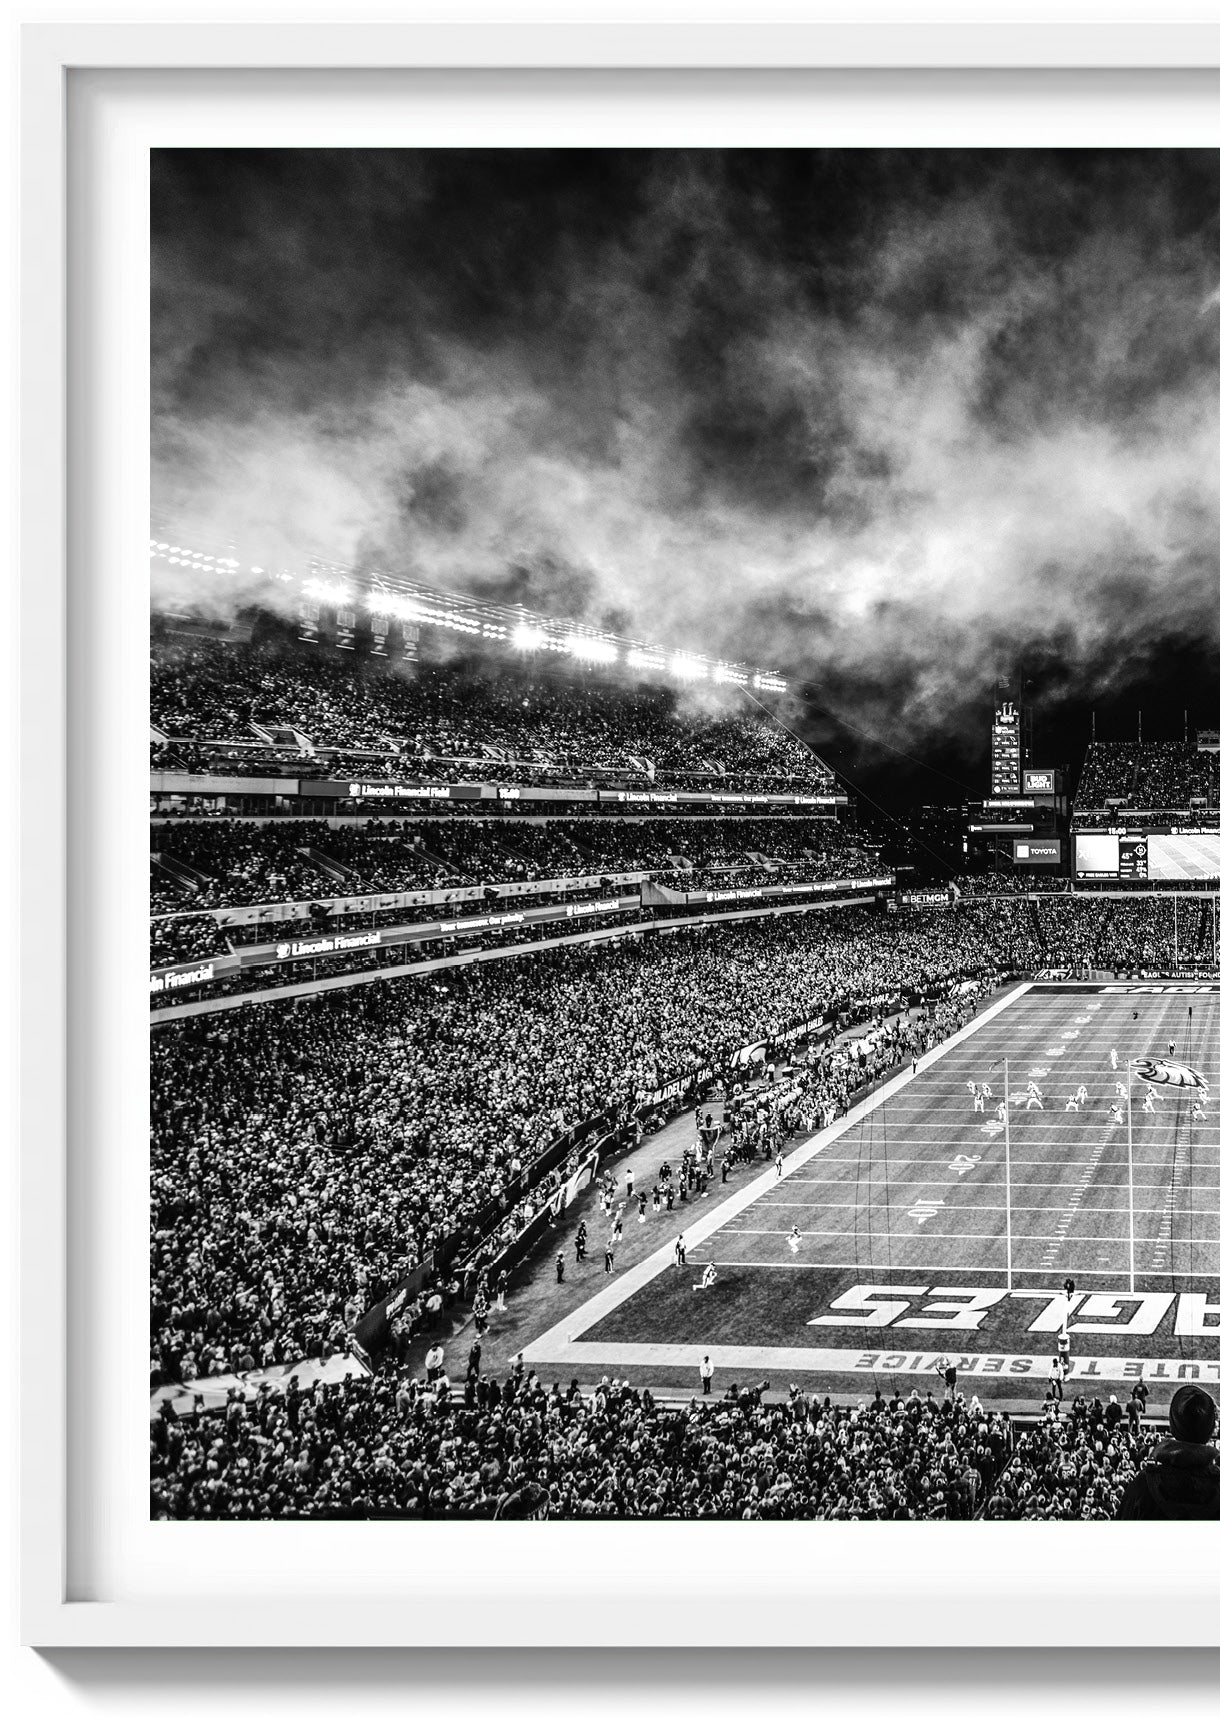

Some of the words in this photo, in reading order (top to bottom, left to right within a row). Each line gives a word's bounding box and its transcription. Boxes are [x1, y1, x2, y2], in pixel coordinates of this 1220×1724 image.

[1027, 781, 1051, 789] LIGHT
[1030, 775, 1048, 783] BUD
[361, 785, 394, 796] Lincoln
[394, 785, 431, 797] Financial
[431, 786, 450, 798] Field
[627, 792, 650, 802] Lincoln
[650, 793, 677, 802] Financial
[1108, 827, 1127, 835] 15:00
[1179, 826, 1201, 834] Lincoln
[714, 891, 736, 901] Lincoln
[736, 889, 762, 898] Financial
[910, 893, 949, 903] BETMGM
[573, 904, 595, 915] Lincoln
[594, 900, 619, 913] Financial
[292, 939, 334, 958] Lincoln
[334, 931, 381, 950] Financial
[165, 963, 214, 989] Financial
[946, 1154, 982, 1171] 20
[907, 1198, 945, 1218] 10
